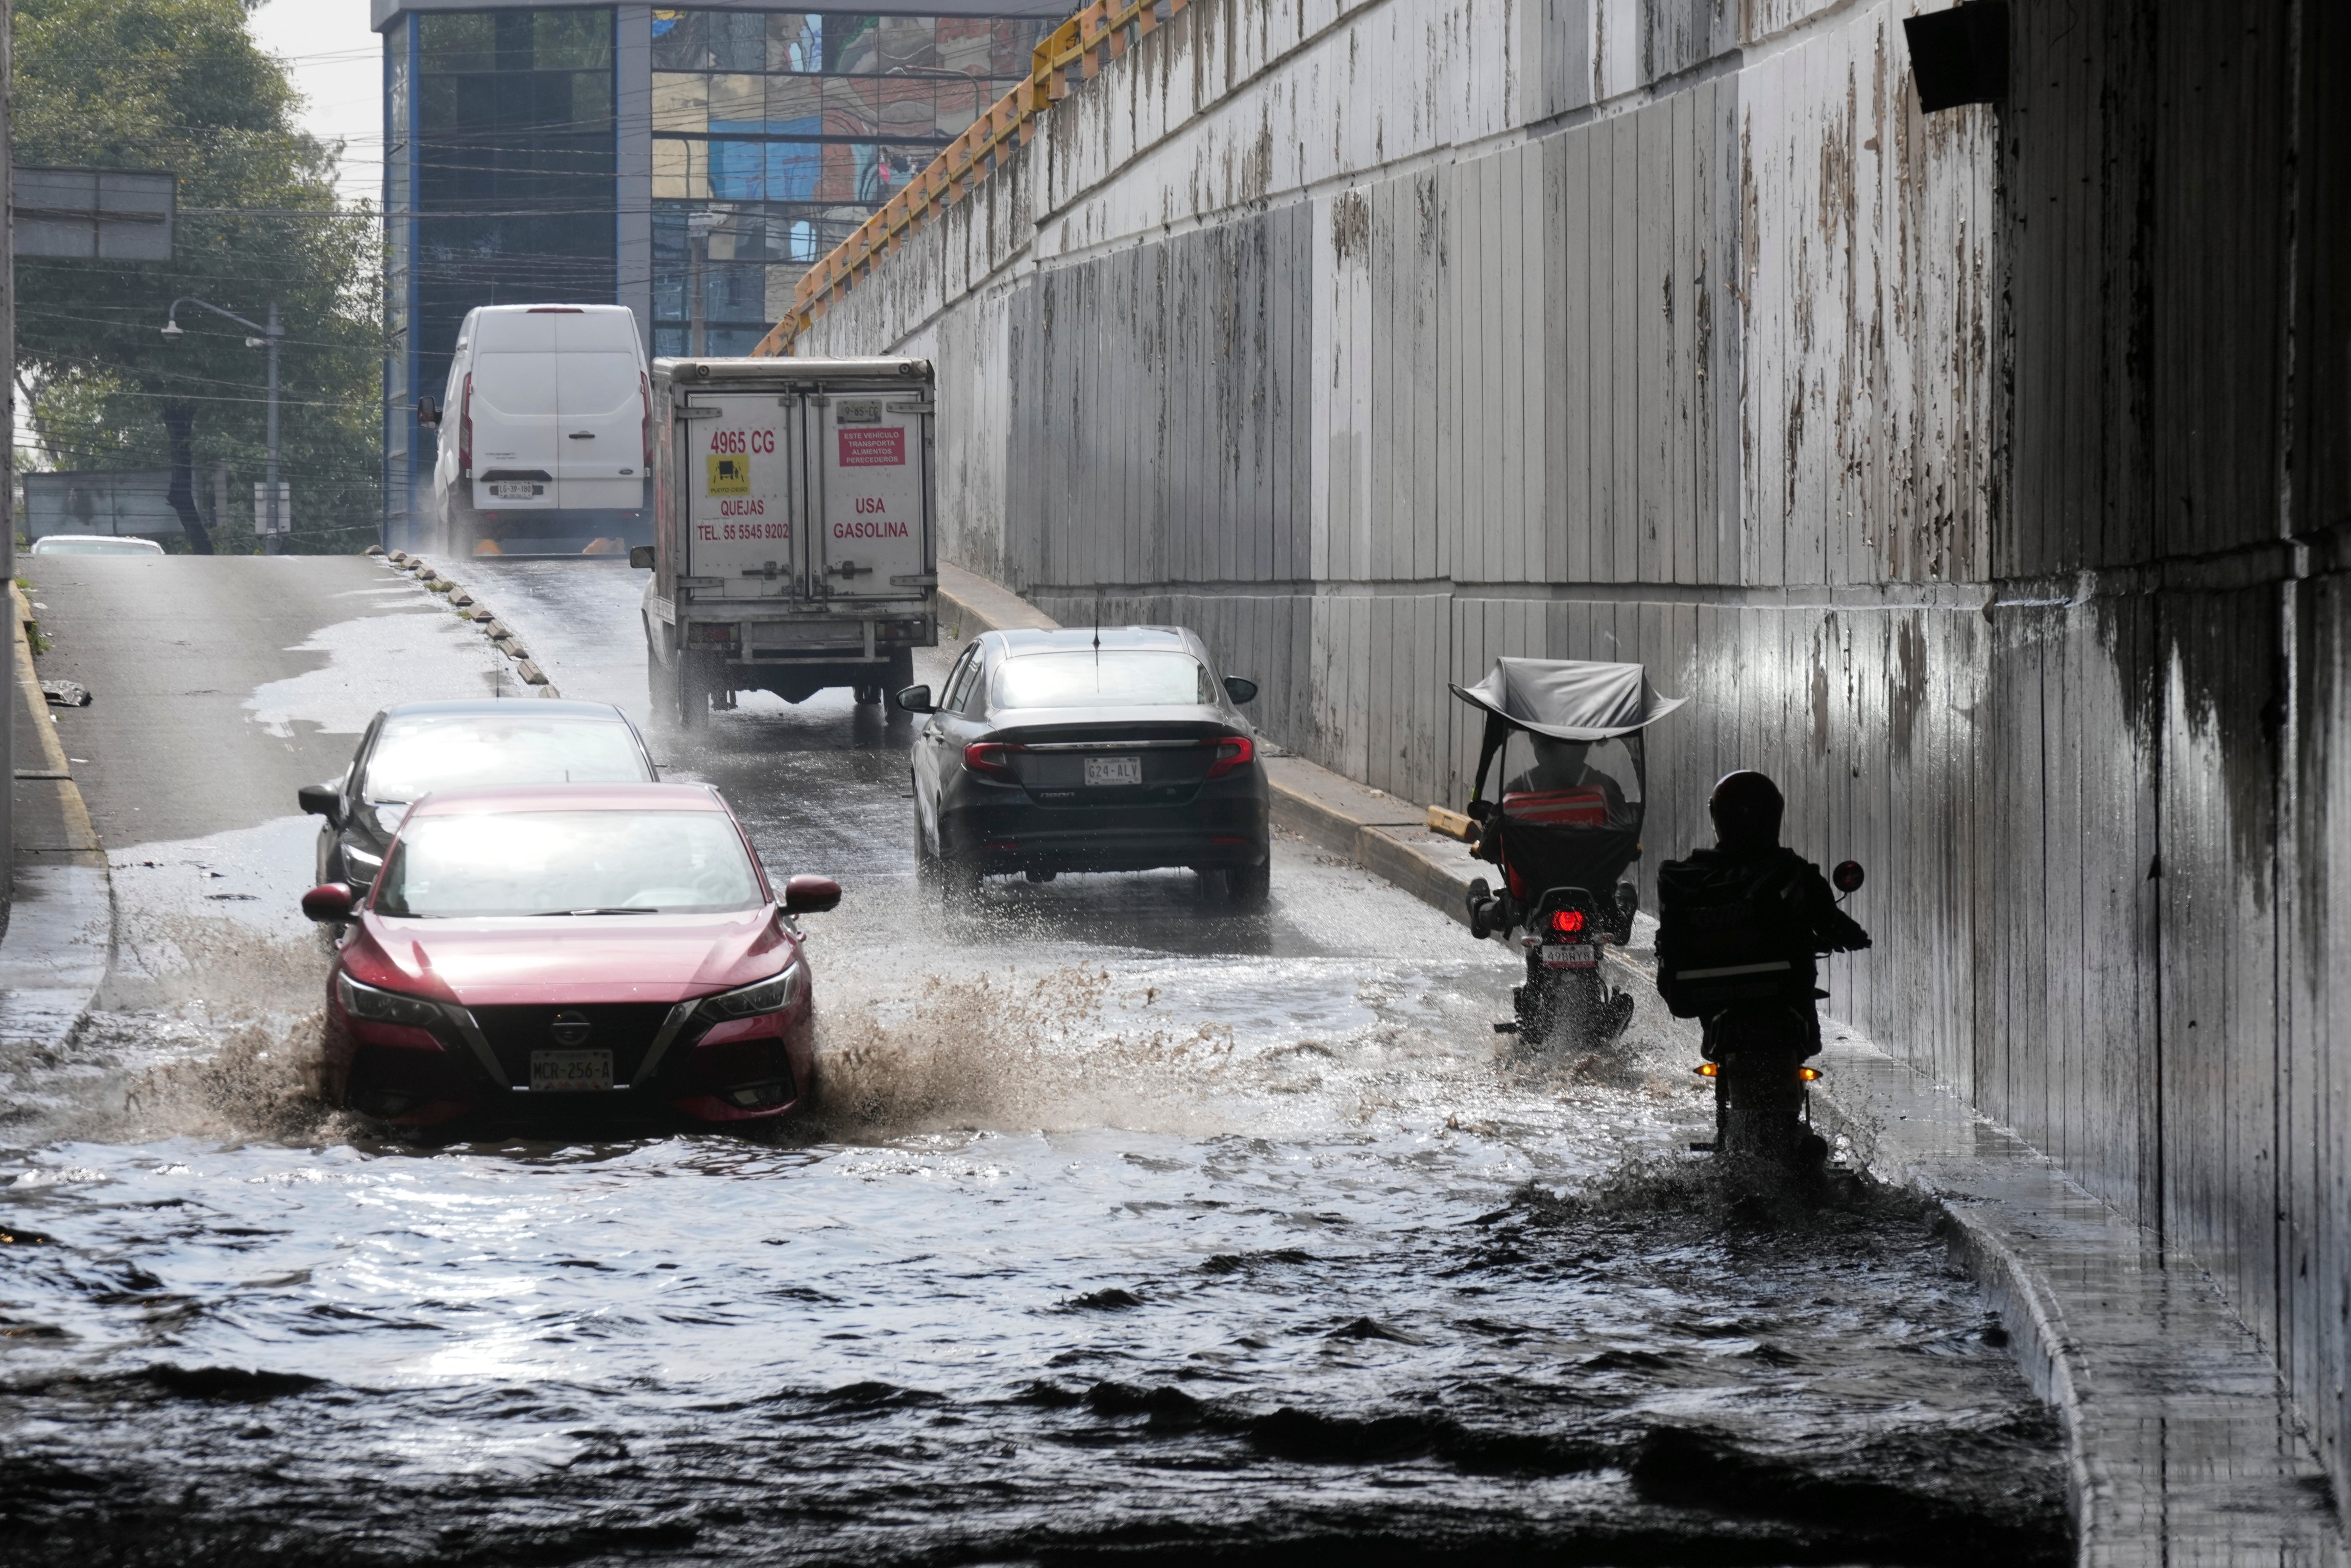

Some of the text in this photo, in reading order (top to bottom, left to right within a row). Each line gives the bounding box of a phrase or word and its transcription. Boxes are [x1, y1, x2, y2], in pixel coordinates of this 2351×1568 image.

[711, 430, 774, 454] 4965 CG
[721, 499, 764, 516] QUEJAS
[855, 498, 886, 514] USA
[698, 523, 788, 540] TEL. 55 5545 9202
[833, 522, 908, 539] GASOLINA
[534, 1061, 610, 1080] MCR-256-A
